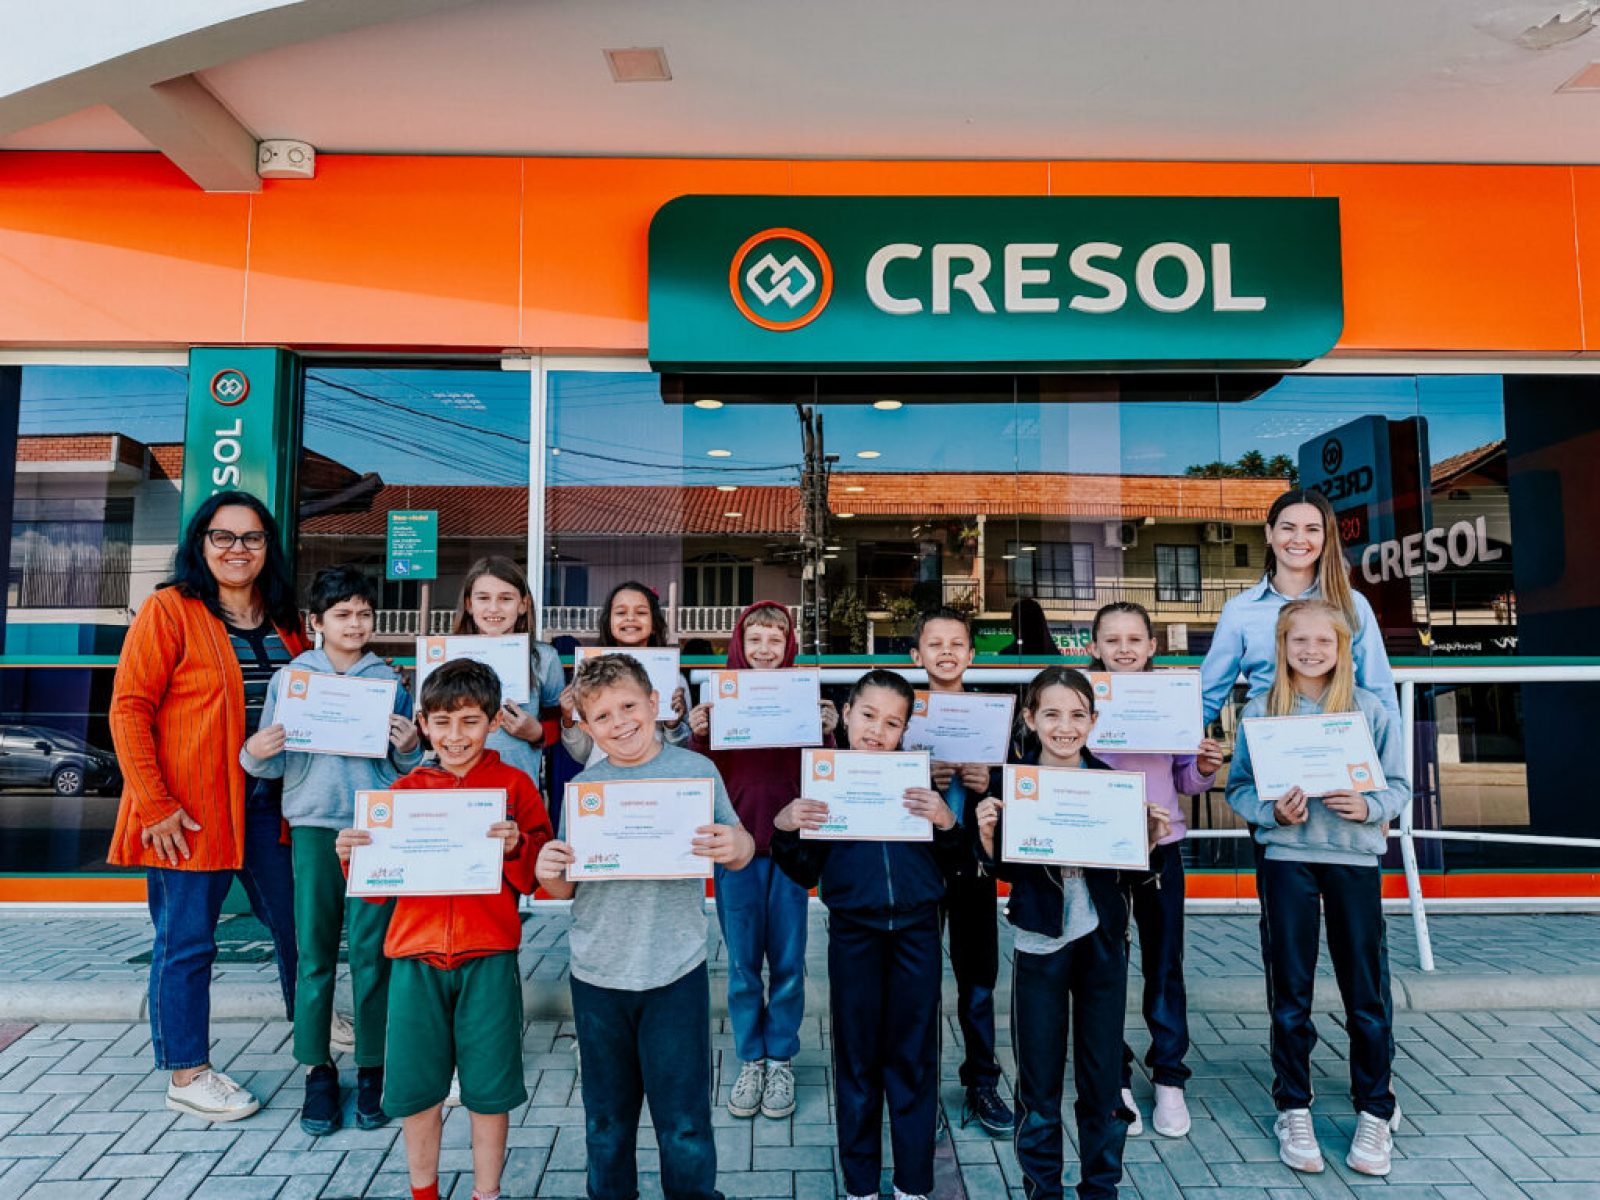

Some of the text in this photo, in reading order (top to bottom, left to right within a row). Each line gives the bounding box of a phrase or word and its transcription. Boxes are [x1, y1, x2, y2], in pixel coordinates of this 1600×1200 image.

[865, 241, 1267, 314] CRESOL
[212, 418, 242, 496] SOL
[1361, 515, 1503, 584] CRESOL
